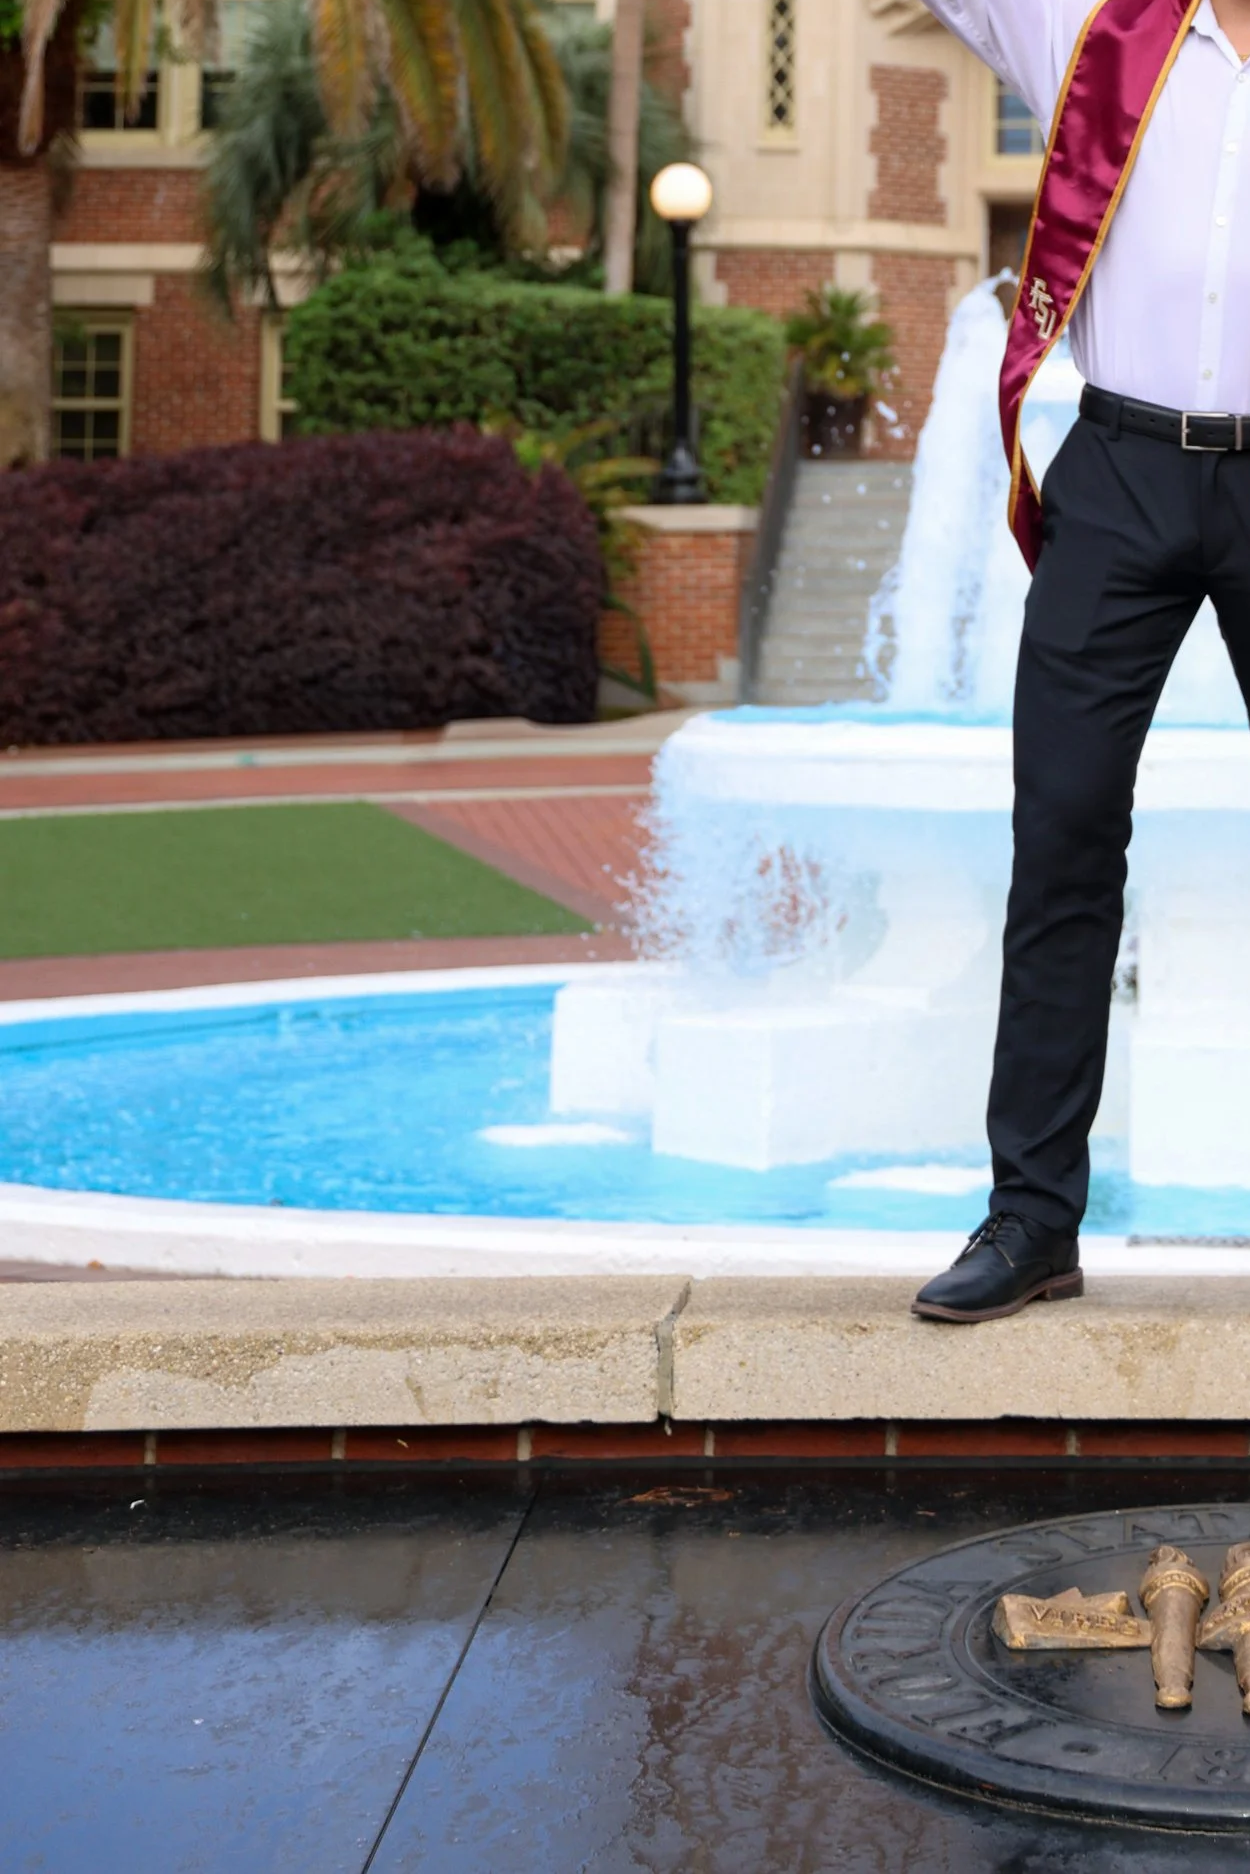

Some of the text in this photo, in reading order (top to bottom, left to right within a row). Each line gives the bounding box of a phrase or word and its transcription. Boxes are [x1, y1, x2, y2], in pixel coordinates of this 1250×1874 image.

[1028, 276, 1057, 340] FSU
[1030, 1604, 1141, 1637] VIRES
[850, 1578, 1056, 1750] FLORIDA
